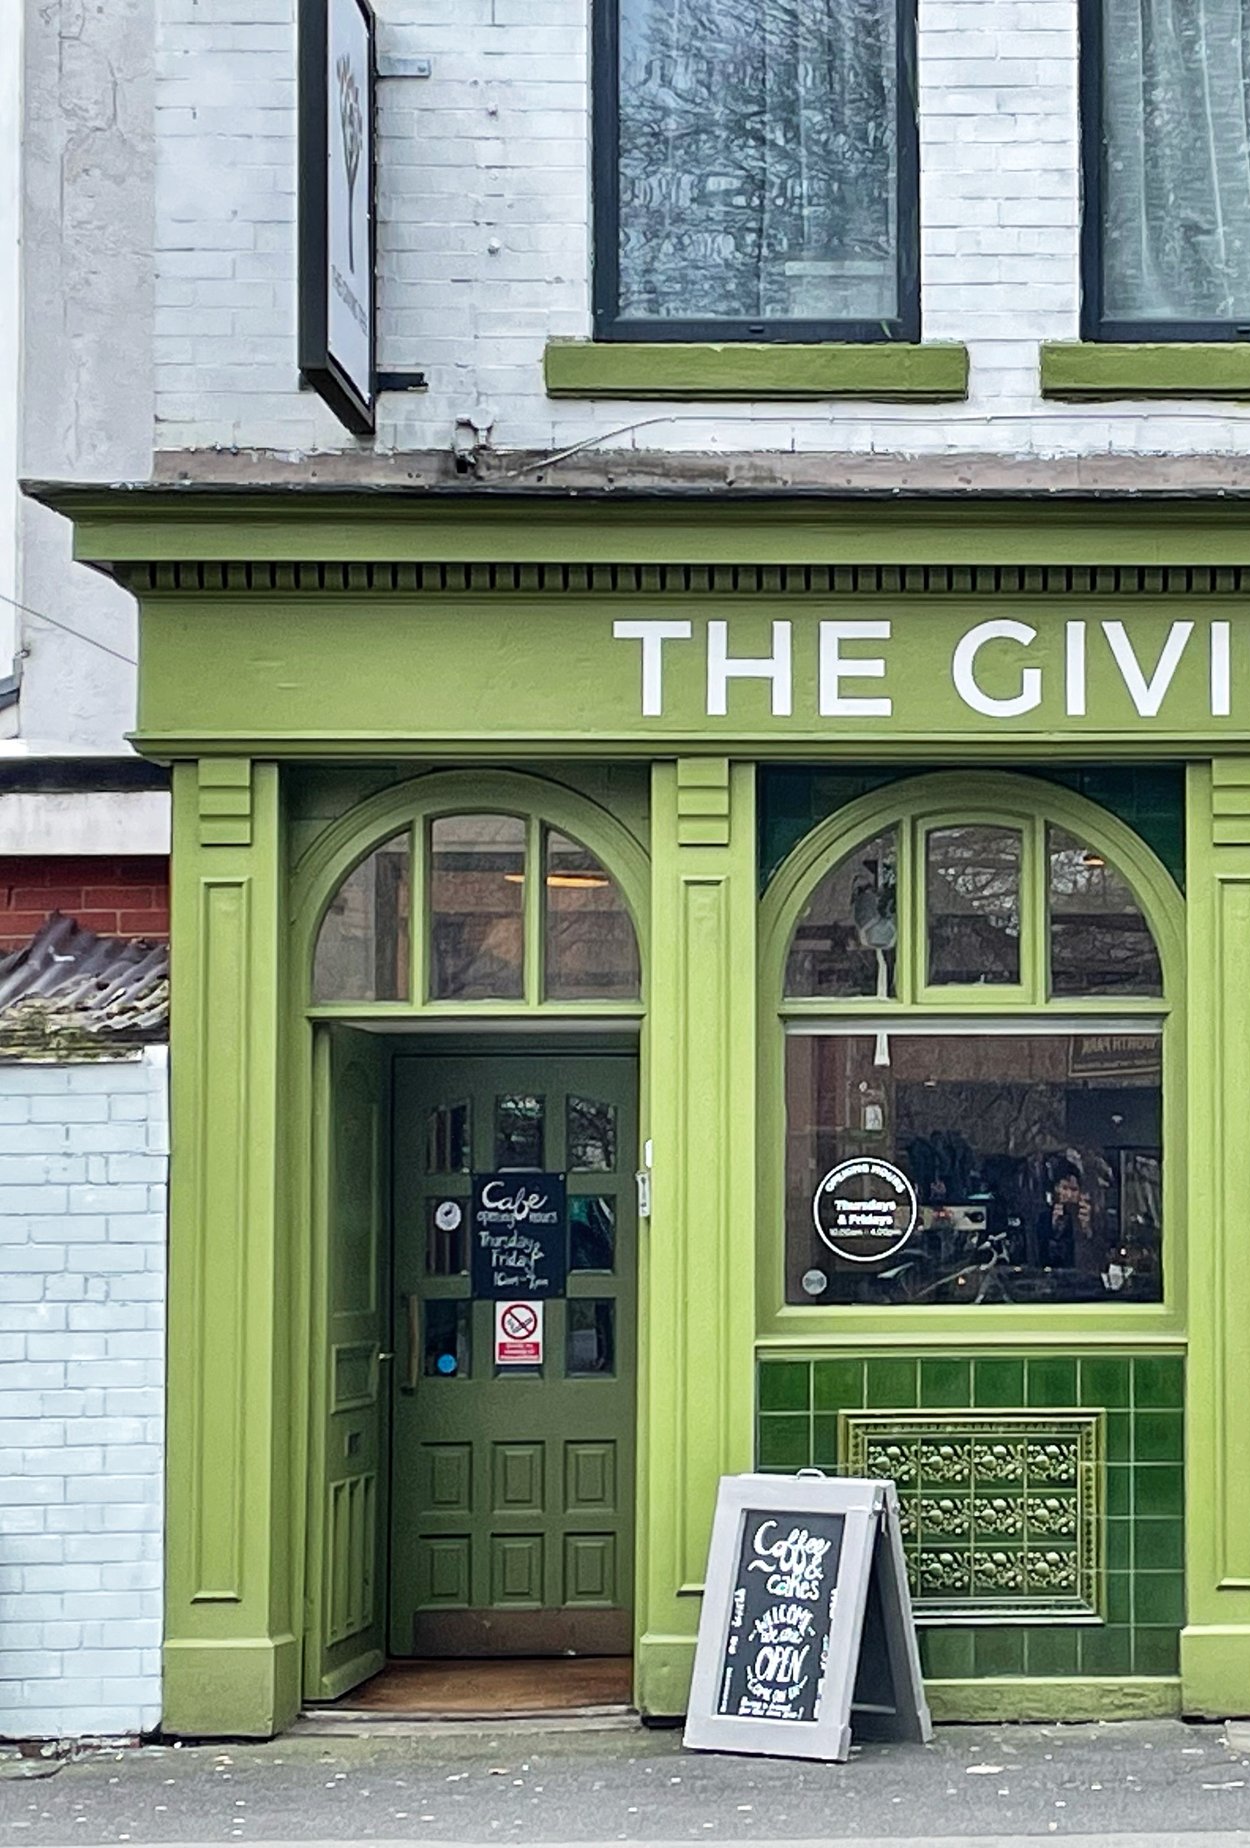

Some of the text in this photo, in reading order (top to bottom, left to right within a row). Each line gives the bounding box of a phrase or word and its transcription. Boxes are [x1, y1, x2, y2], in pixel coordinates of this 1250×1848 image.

[613, 620, 892, 716] THE
[824, 1163, 906, 1194] OPENING HOURS
[834, 1199, 897, 1212] Thursdays
[476, 1211, 516, 1230] opening
[836, 1213, 894, 1226] & Fridays
[478, 1230, 534, 1254] Thursday
[491, 1249, 535, 1276] Friday
[753, 1520, 832, 1573] Coffee
[754, 1644, 811, 1684] OPEN
